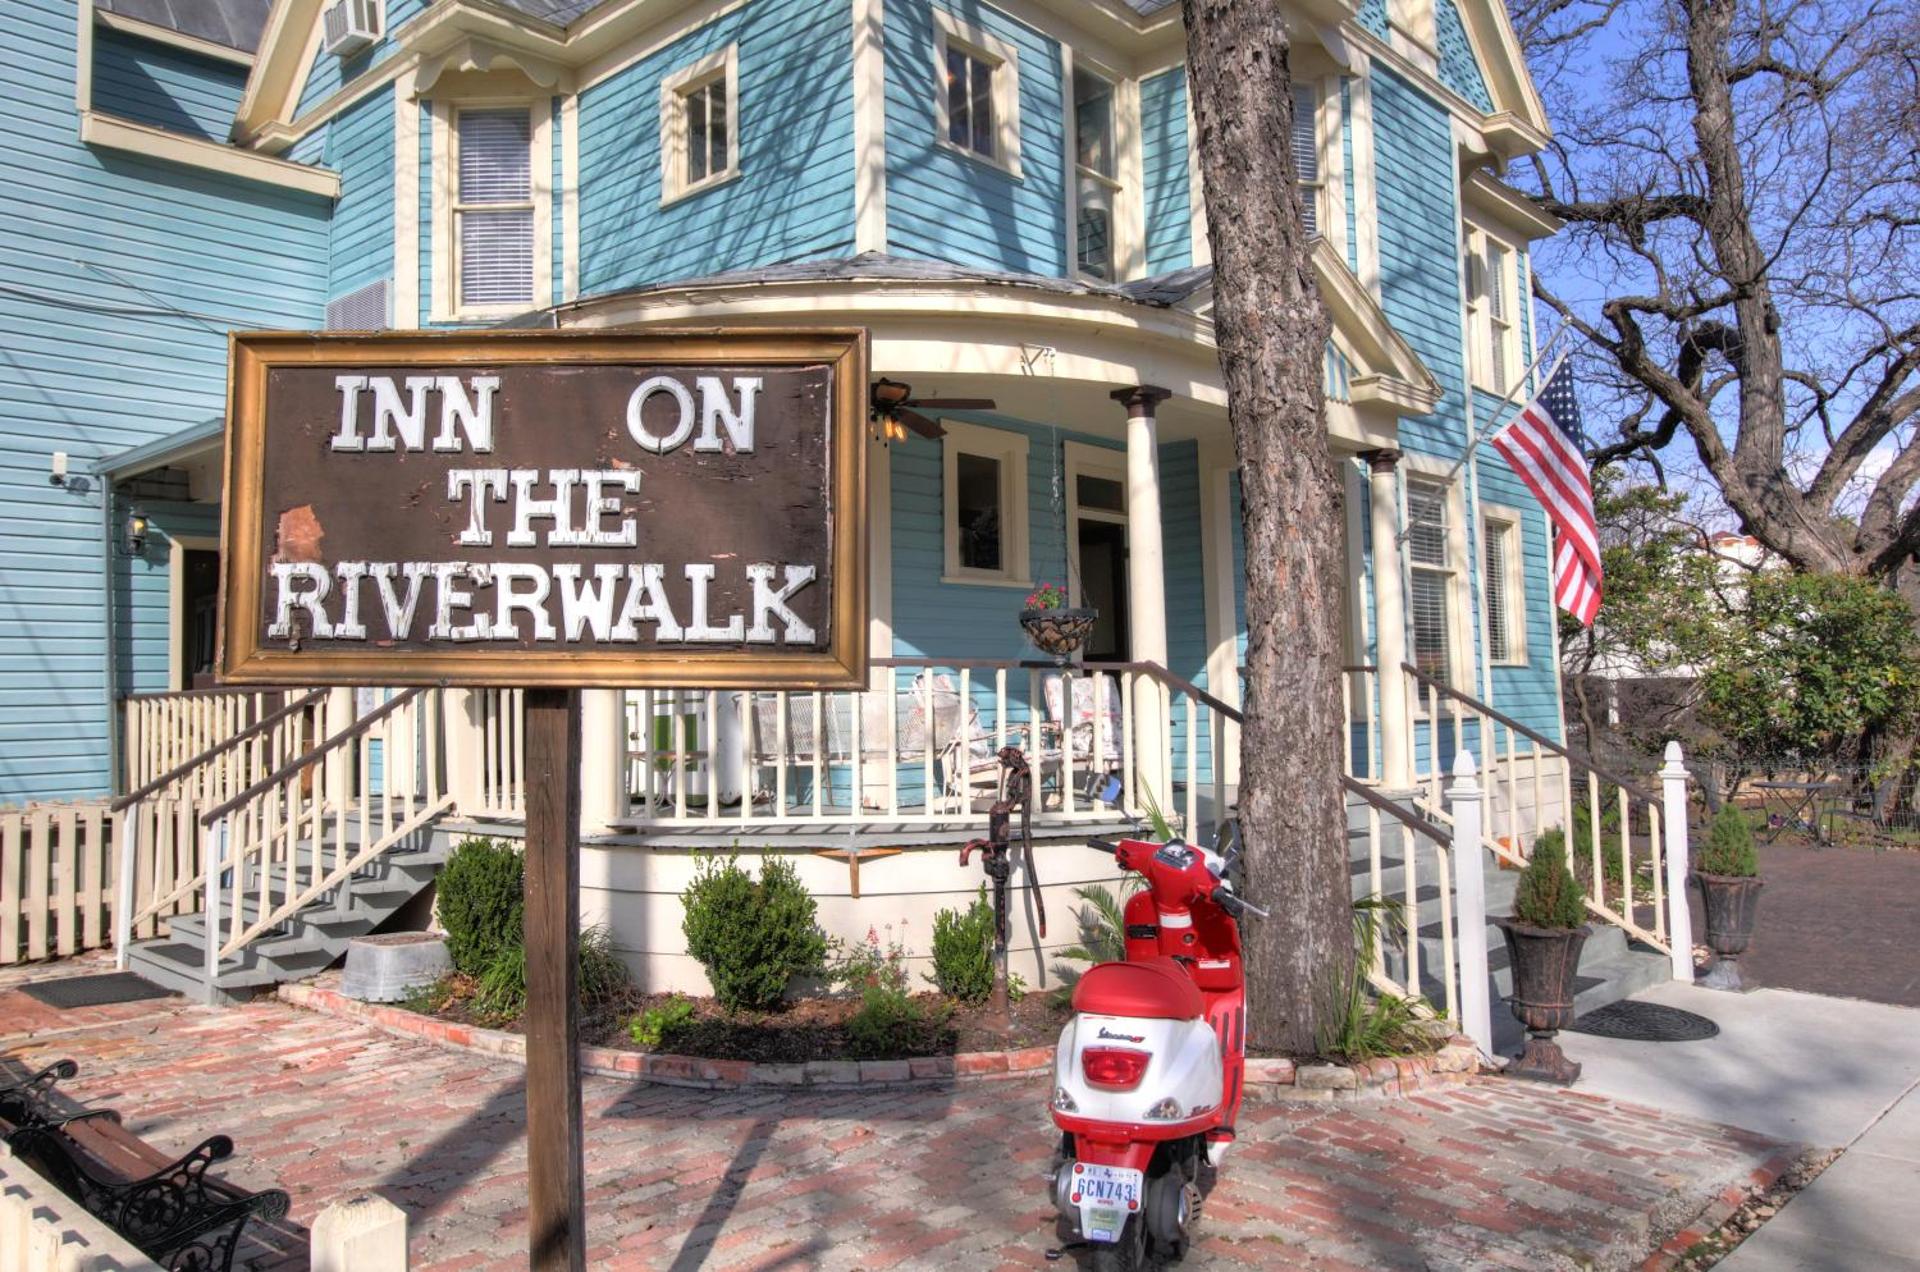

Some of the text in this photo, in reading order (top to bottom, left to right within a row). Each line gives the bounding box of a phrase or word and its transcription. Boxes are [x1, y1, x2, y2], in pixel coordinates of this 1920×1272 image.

[331, 375, 763, 455] INN ON
[448, 469, 641, 547] THE
[268, 562, 817, 645] RIVERWALK
[1077, 1178, 1133, 1201] 6CN743
